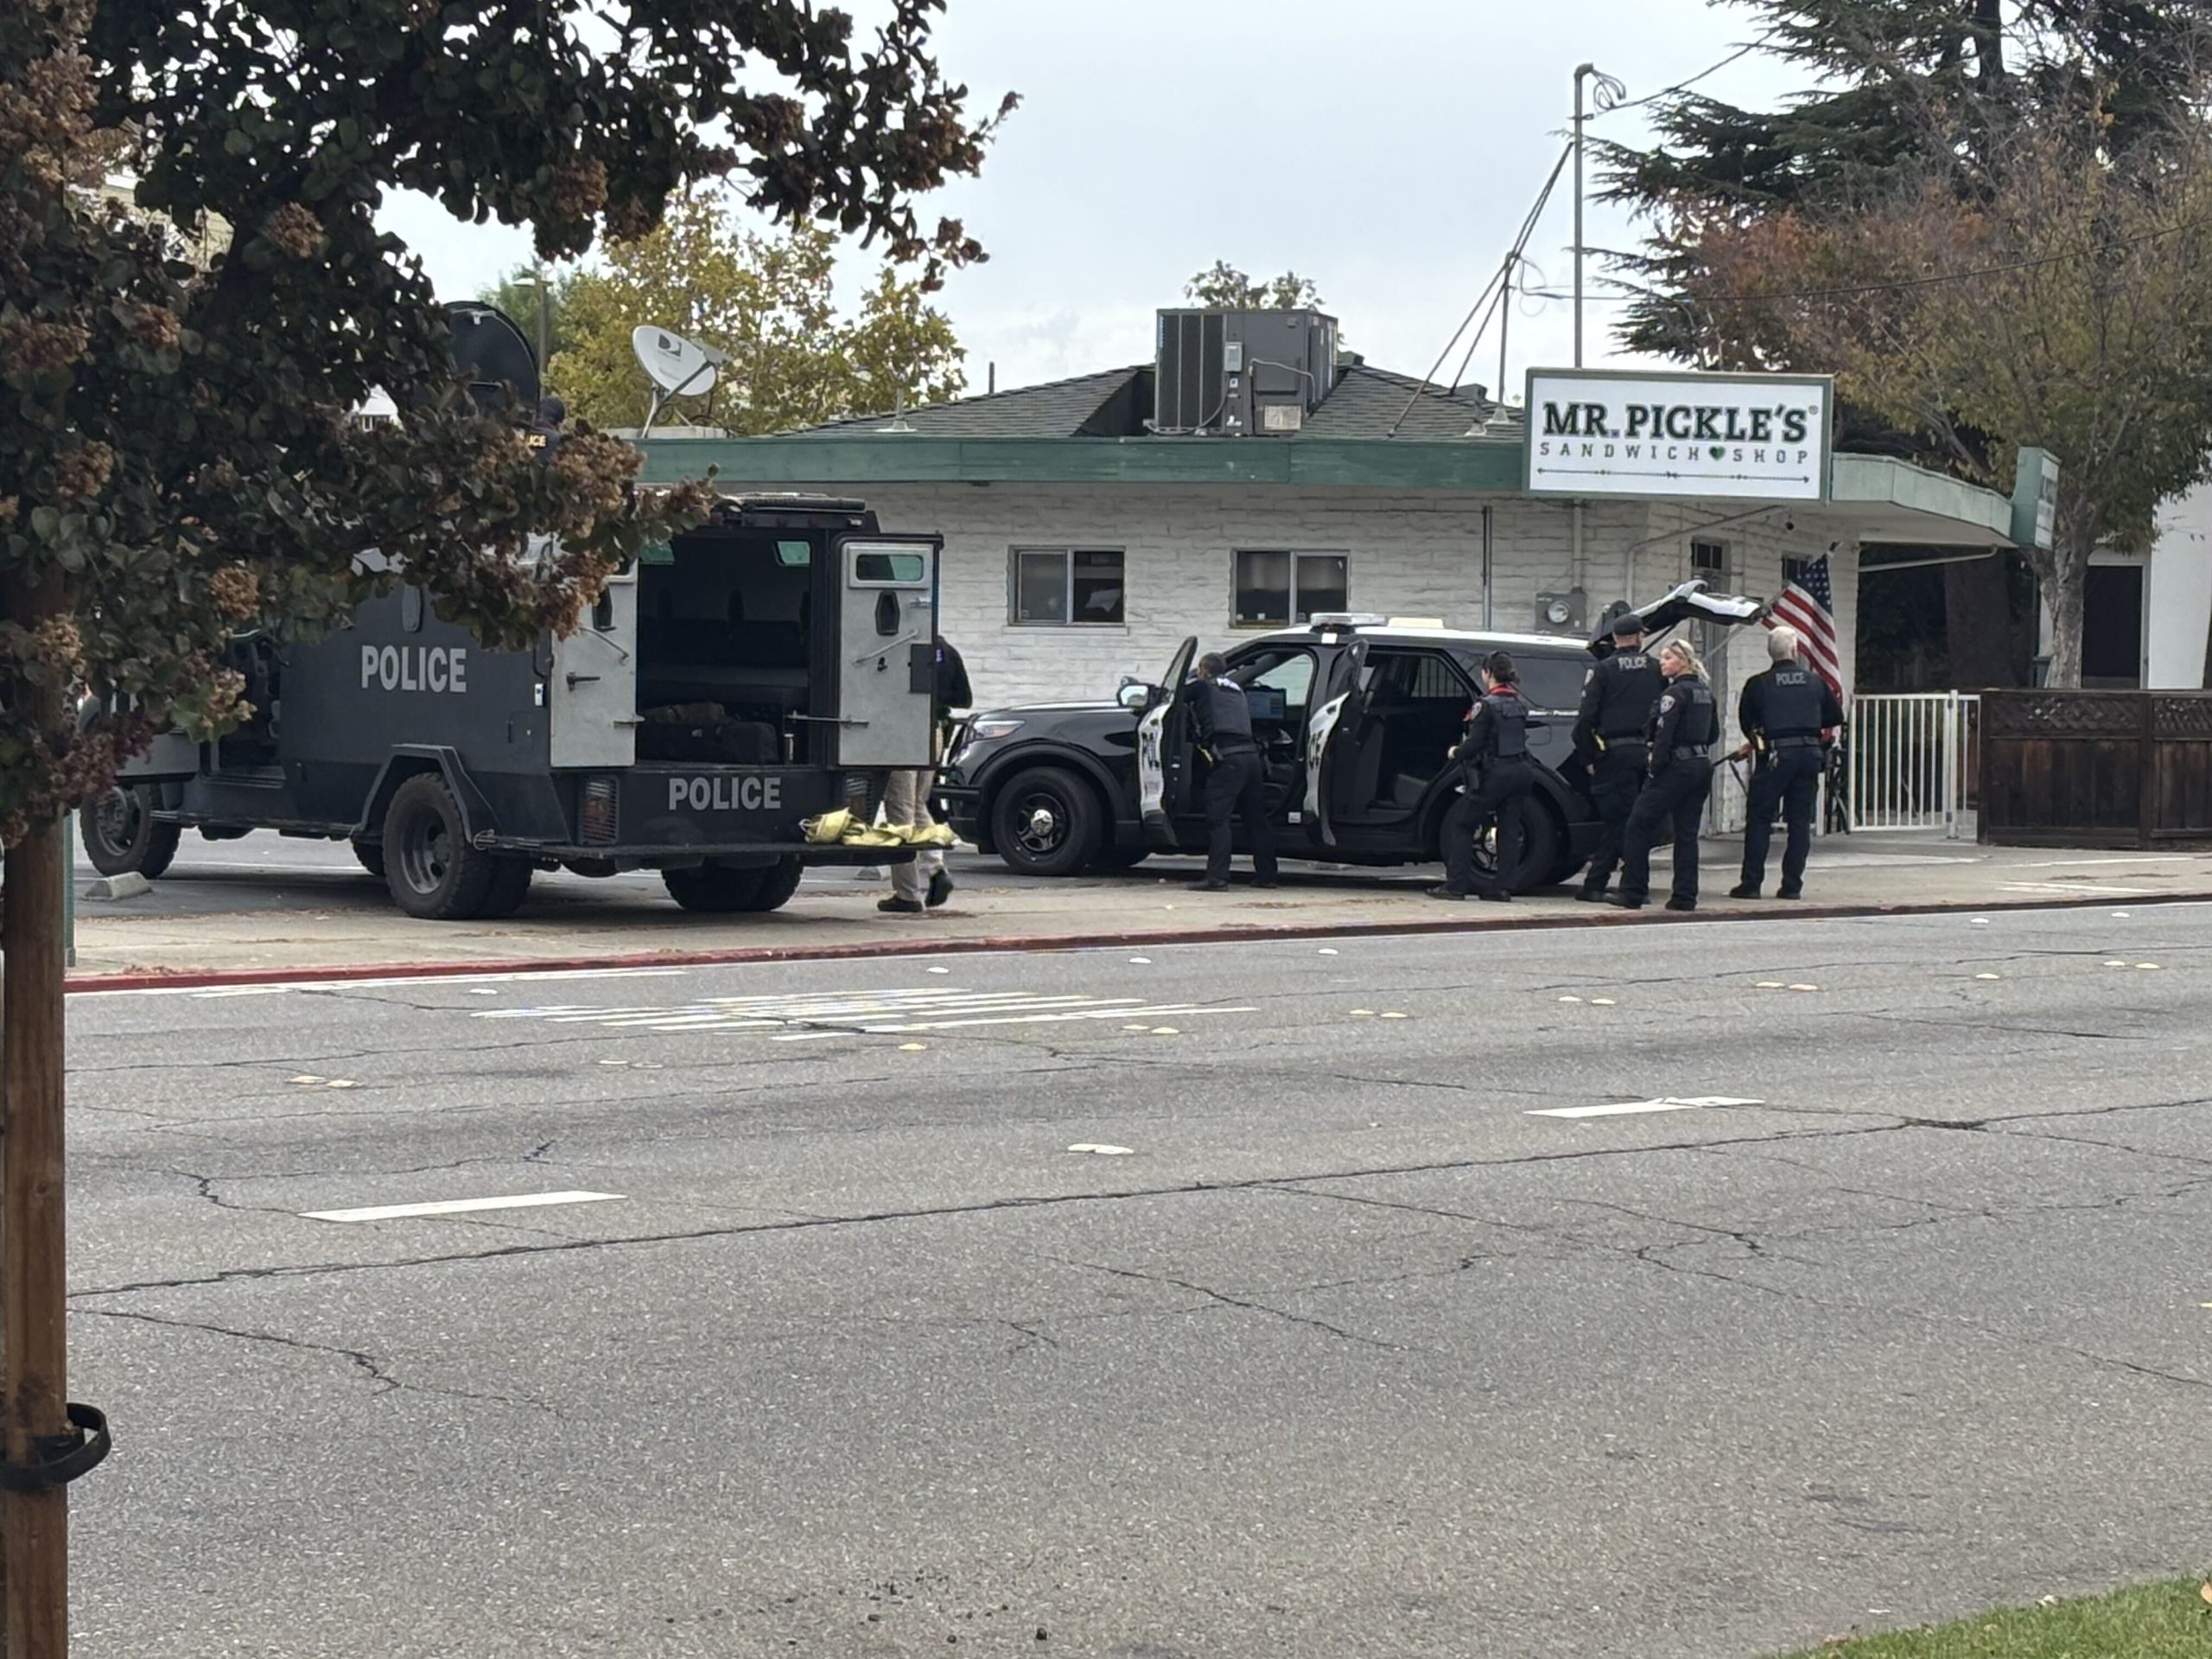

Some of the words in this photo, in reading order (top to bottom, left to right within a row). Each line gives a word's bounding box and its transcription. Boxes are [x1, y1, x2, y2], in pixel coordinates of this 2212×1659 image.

[1542, 402, 1620, 439] MR.
[1624, 403, 1808, 444] PICKLE'S
[1540, 442, 1699, 461] SANDWICH
[1732, 448, 1808, 464] SHOP
[361, 645, 467, 693] POLICE
[1775, 671, 1806, 686] POLICE
[669, 777, 781, 810] POLICE
